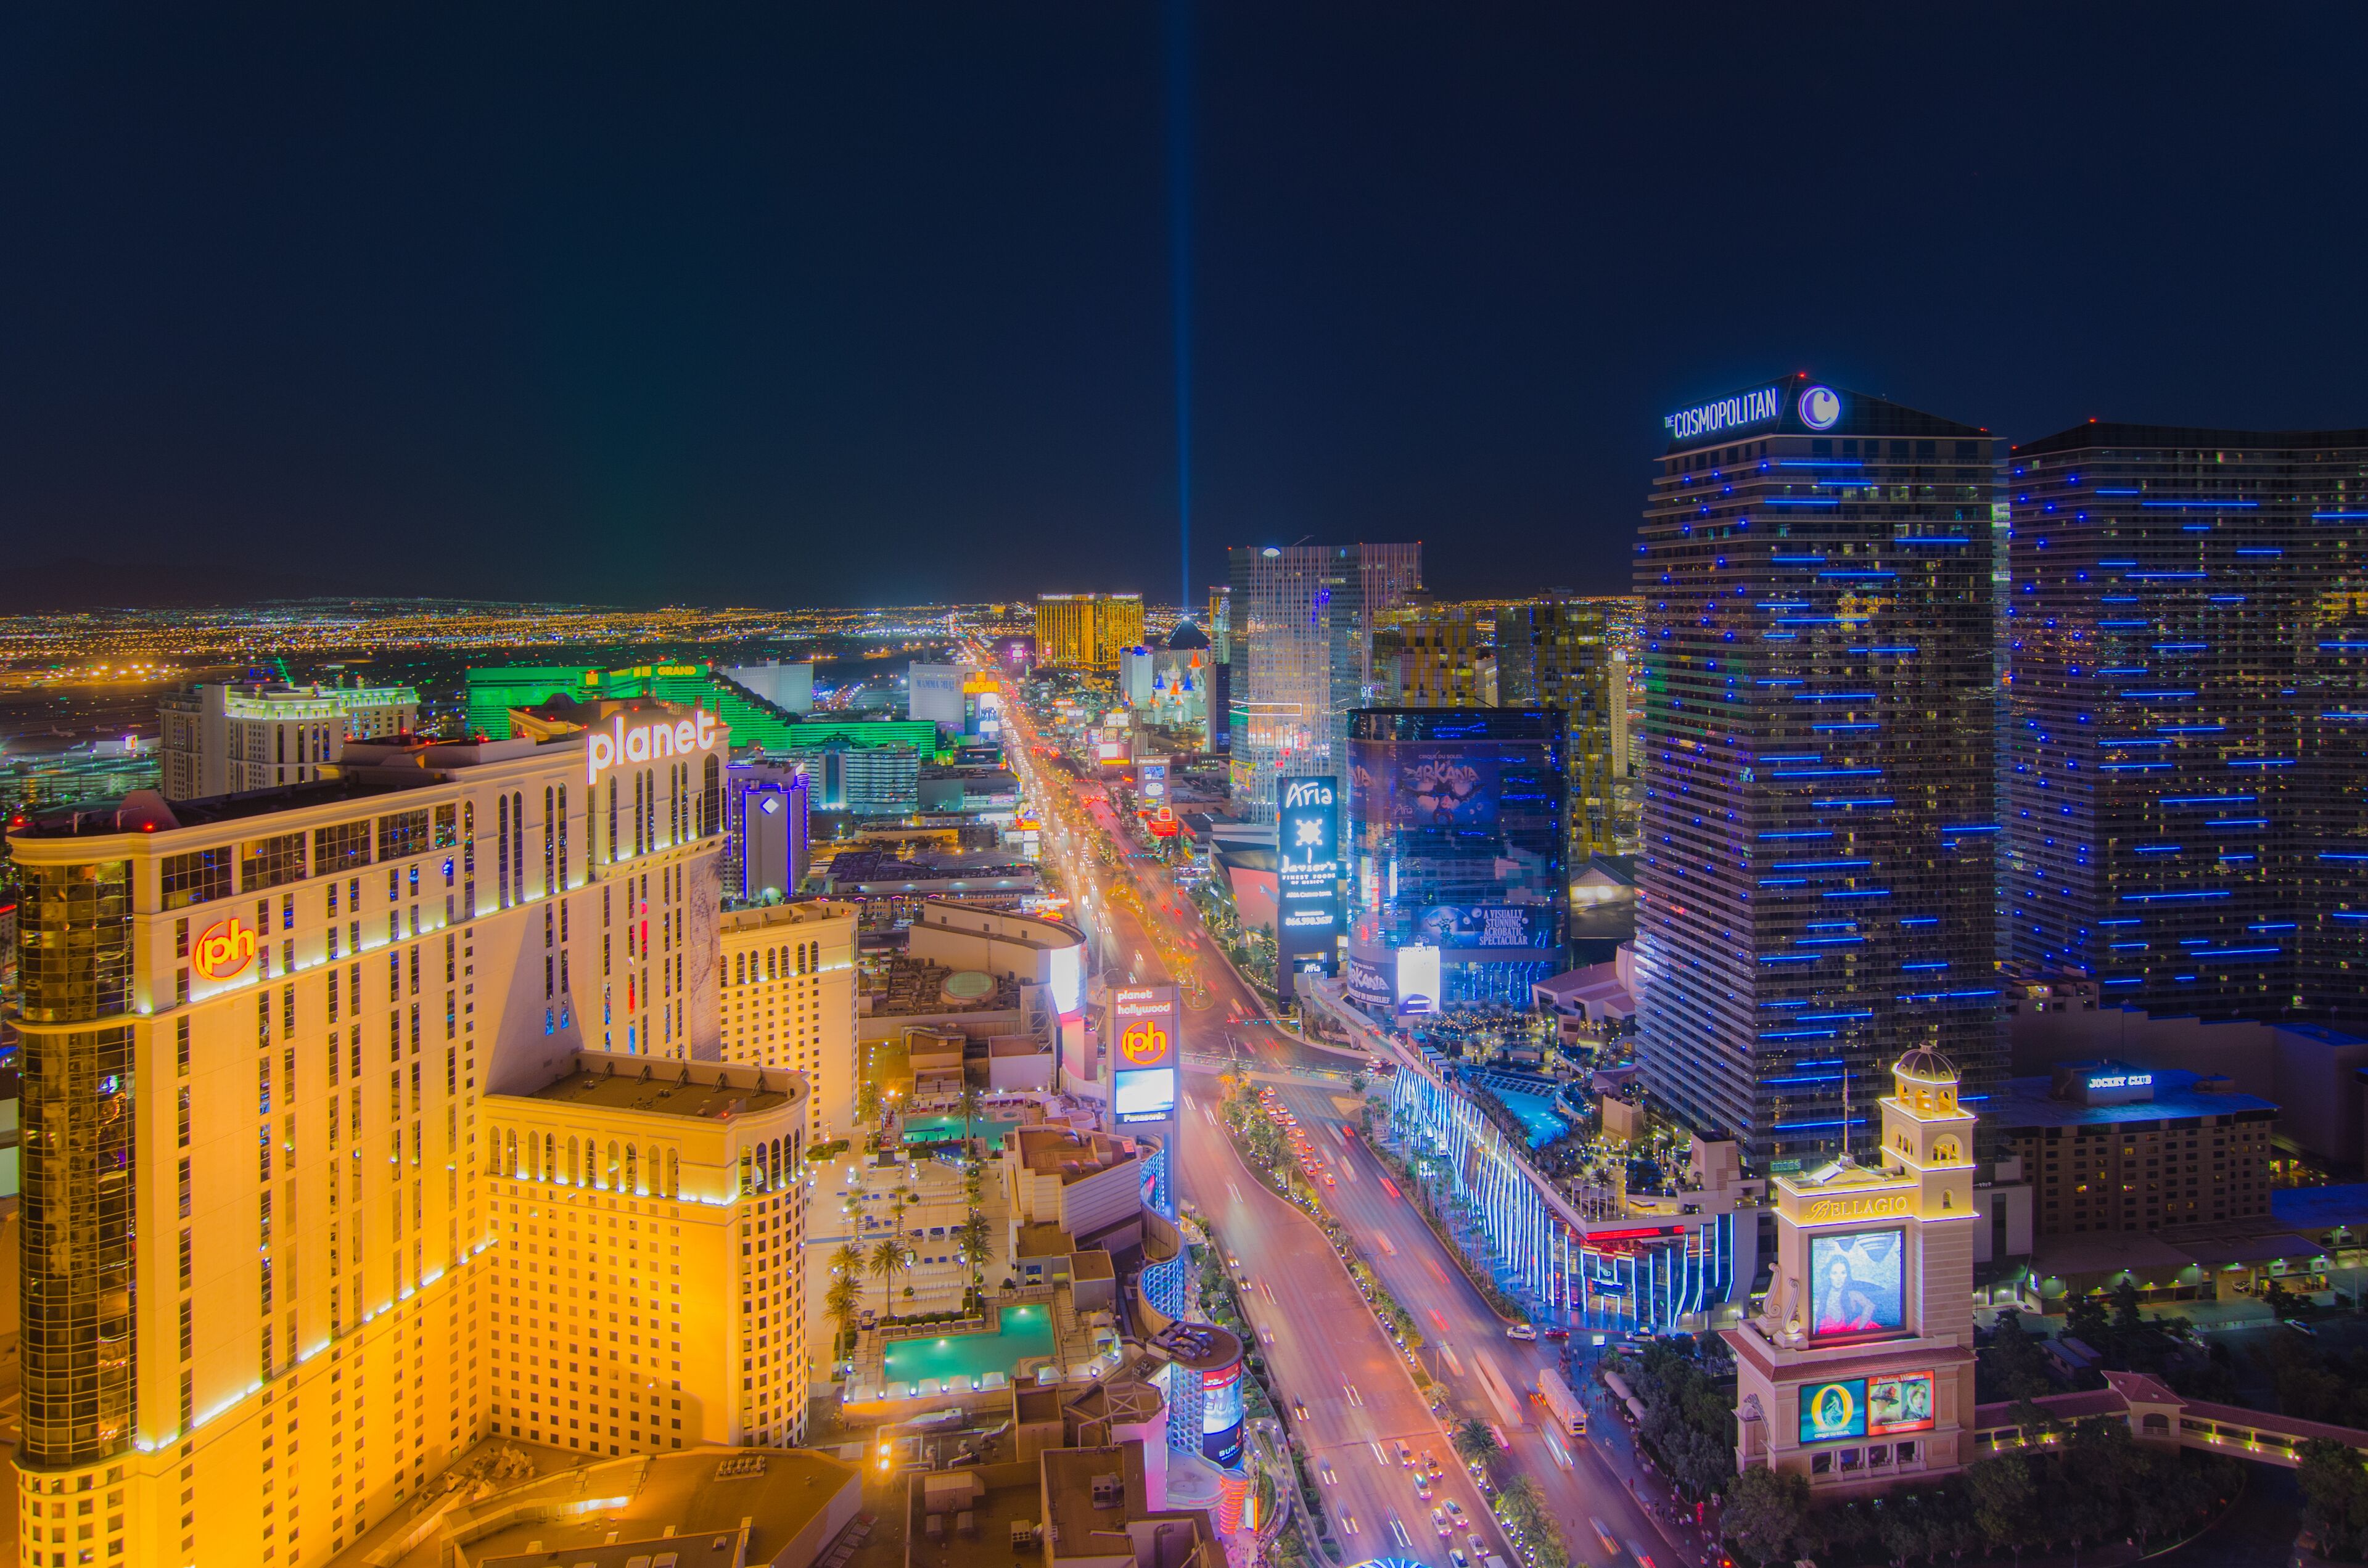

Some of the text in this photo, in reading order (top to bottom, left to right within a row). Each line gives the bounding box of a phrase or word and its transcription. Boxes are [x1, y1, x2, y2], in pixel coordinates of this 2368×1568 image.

[1664, 388, 1777, 438] THE COSMOPOLITAN
[657, 666, 697, 676] GRAND
[963, 681, 999, 694] MGM
[588, 710, 716, 786] planet
[1286, 782, 1332, 808] Aria
[1483, 909, 1523, 919] A VISUALLY
[1486, 918, 1521, 928] STUNNING
[1484, 927, 1524, 937] ACROBATIC
[201, 917, 255, 976] ph
[1479, 935, 1529, 946] SPECTACULAR
[1117, 988, 1153, 1003] planet
[1366, 993, 1391, 1004] DISBELIEF
[1117, 1003, 1171, 1016] hollywood
[1127, 1020, 1167, 1061] ph
[2089, 1075, 2152, 1088] JOCKEY CLUB
[1123, 1112, 1167, 1123] Panasonic
[1805, 1196, 1909, 1220] BELLAGIO
